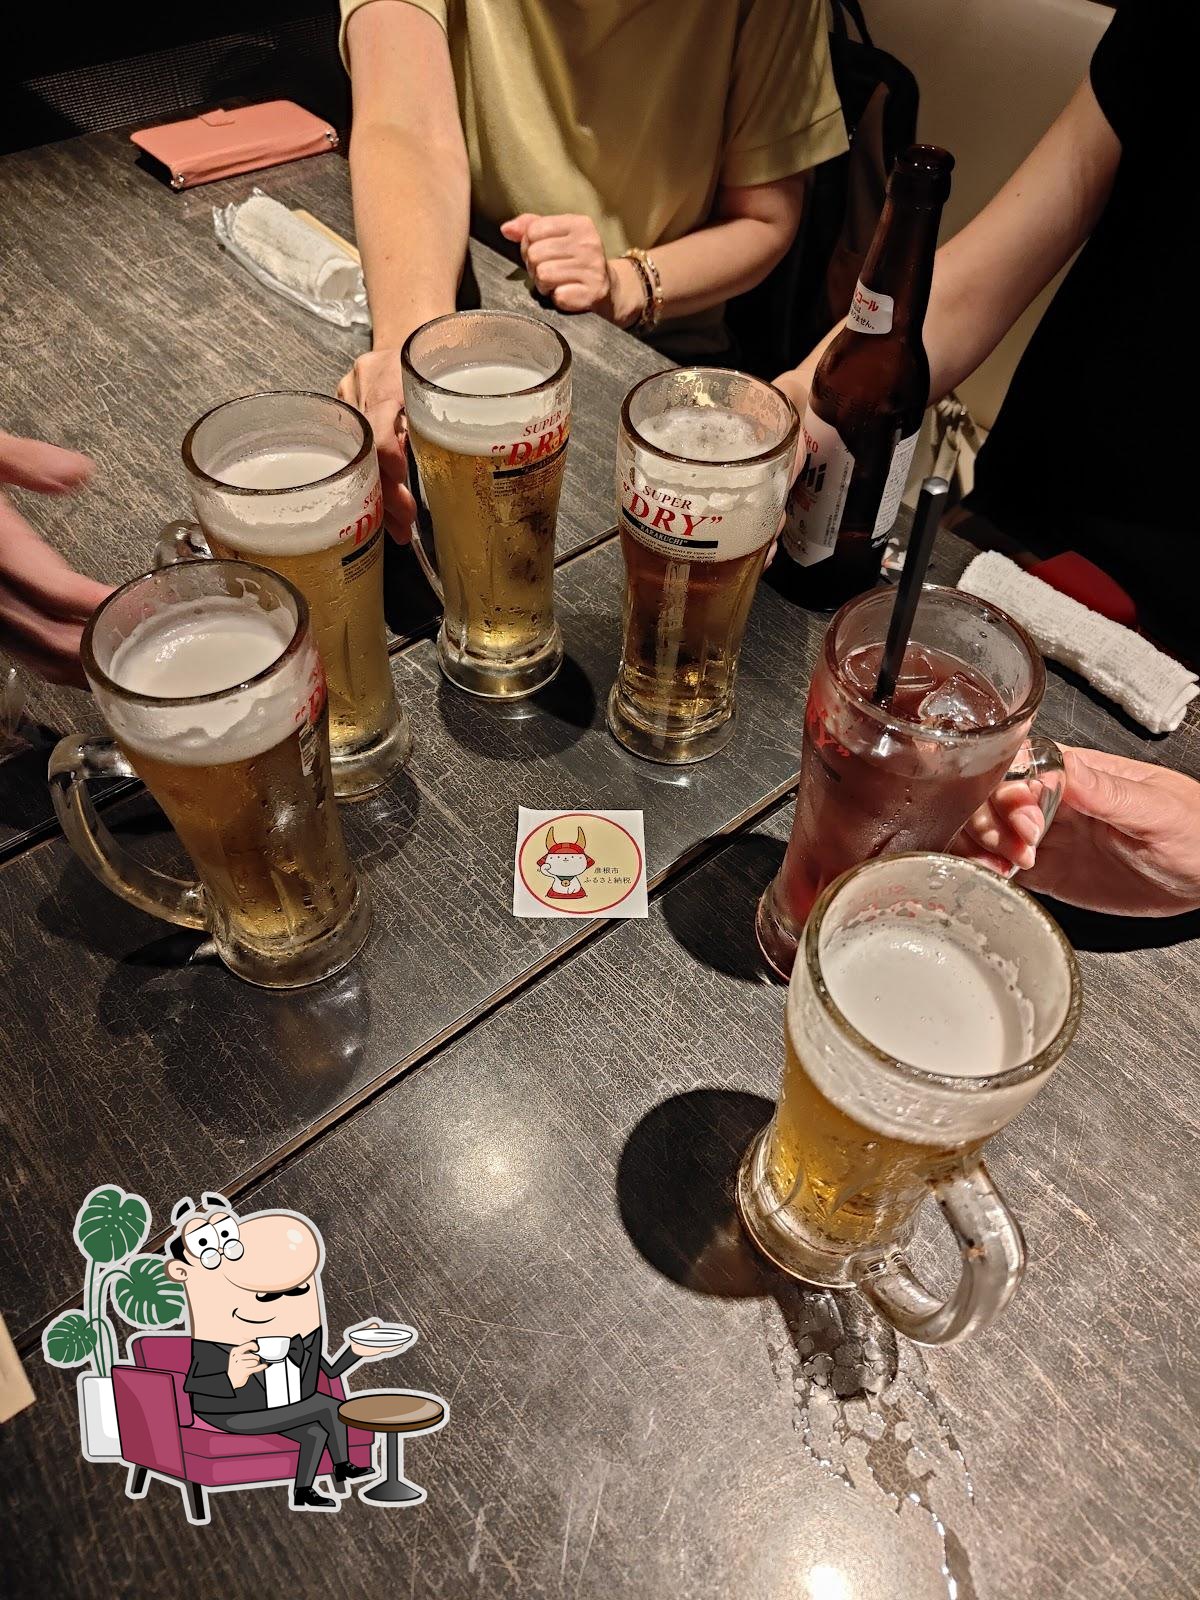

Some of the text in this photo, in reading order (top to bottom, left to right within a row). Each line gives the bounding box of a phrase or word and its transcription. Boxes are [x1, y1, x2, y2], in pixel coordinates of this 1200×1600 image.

[523, 410, 562, 437] SUPER
[642, 485, 692, 510] SUPER
[584, 876, 632, 884] ふるさと納税
